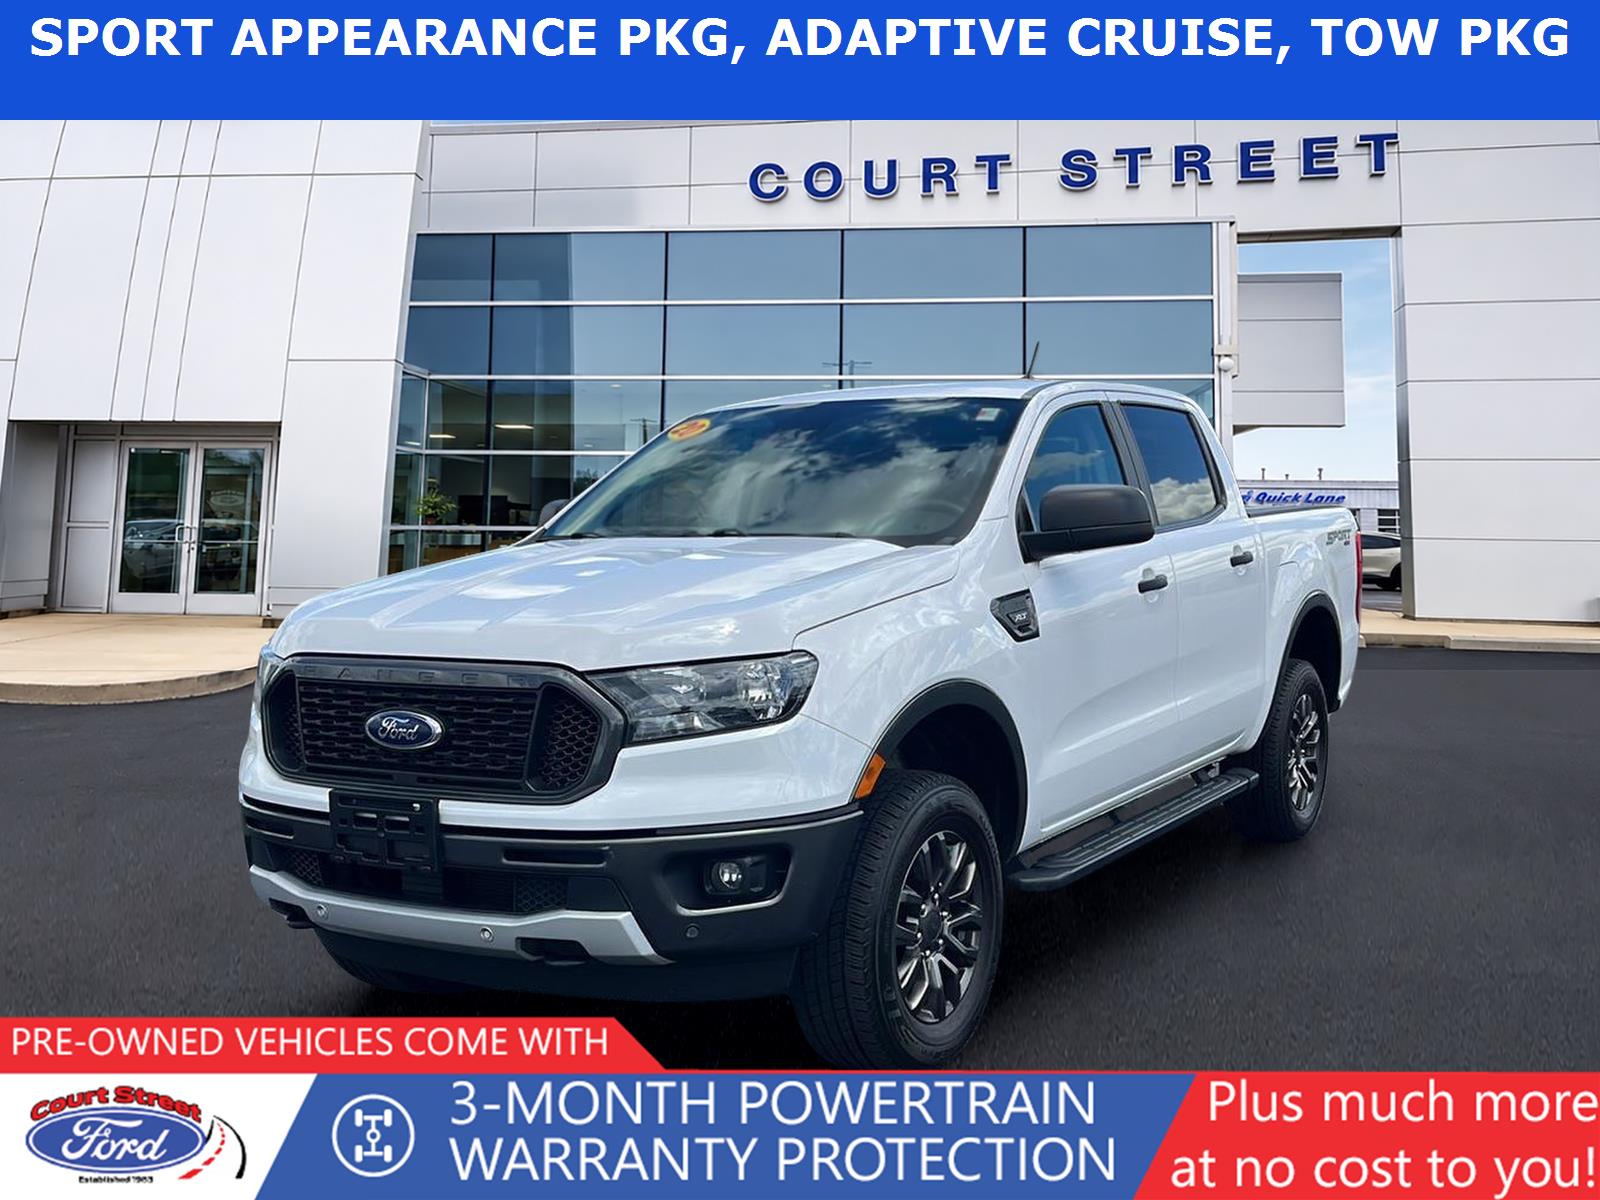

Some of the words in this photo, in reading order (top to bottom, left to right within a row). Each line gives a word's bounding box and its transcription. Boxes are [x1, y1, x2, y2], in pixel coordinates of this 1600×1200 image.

[749, 153, 1010, 201] COURT
[1060, 132, 1399, 190] STREET
[1255, 492, 1302, 504] Quick
[1304, 492, 1346, 504] Lane
[378, 716, 419, 740] Ford
